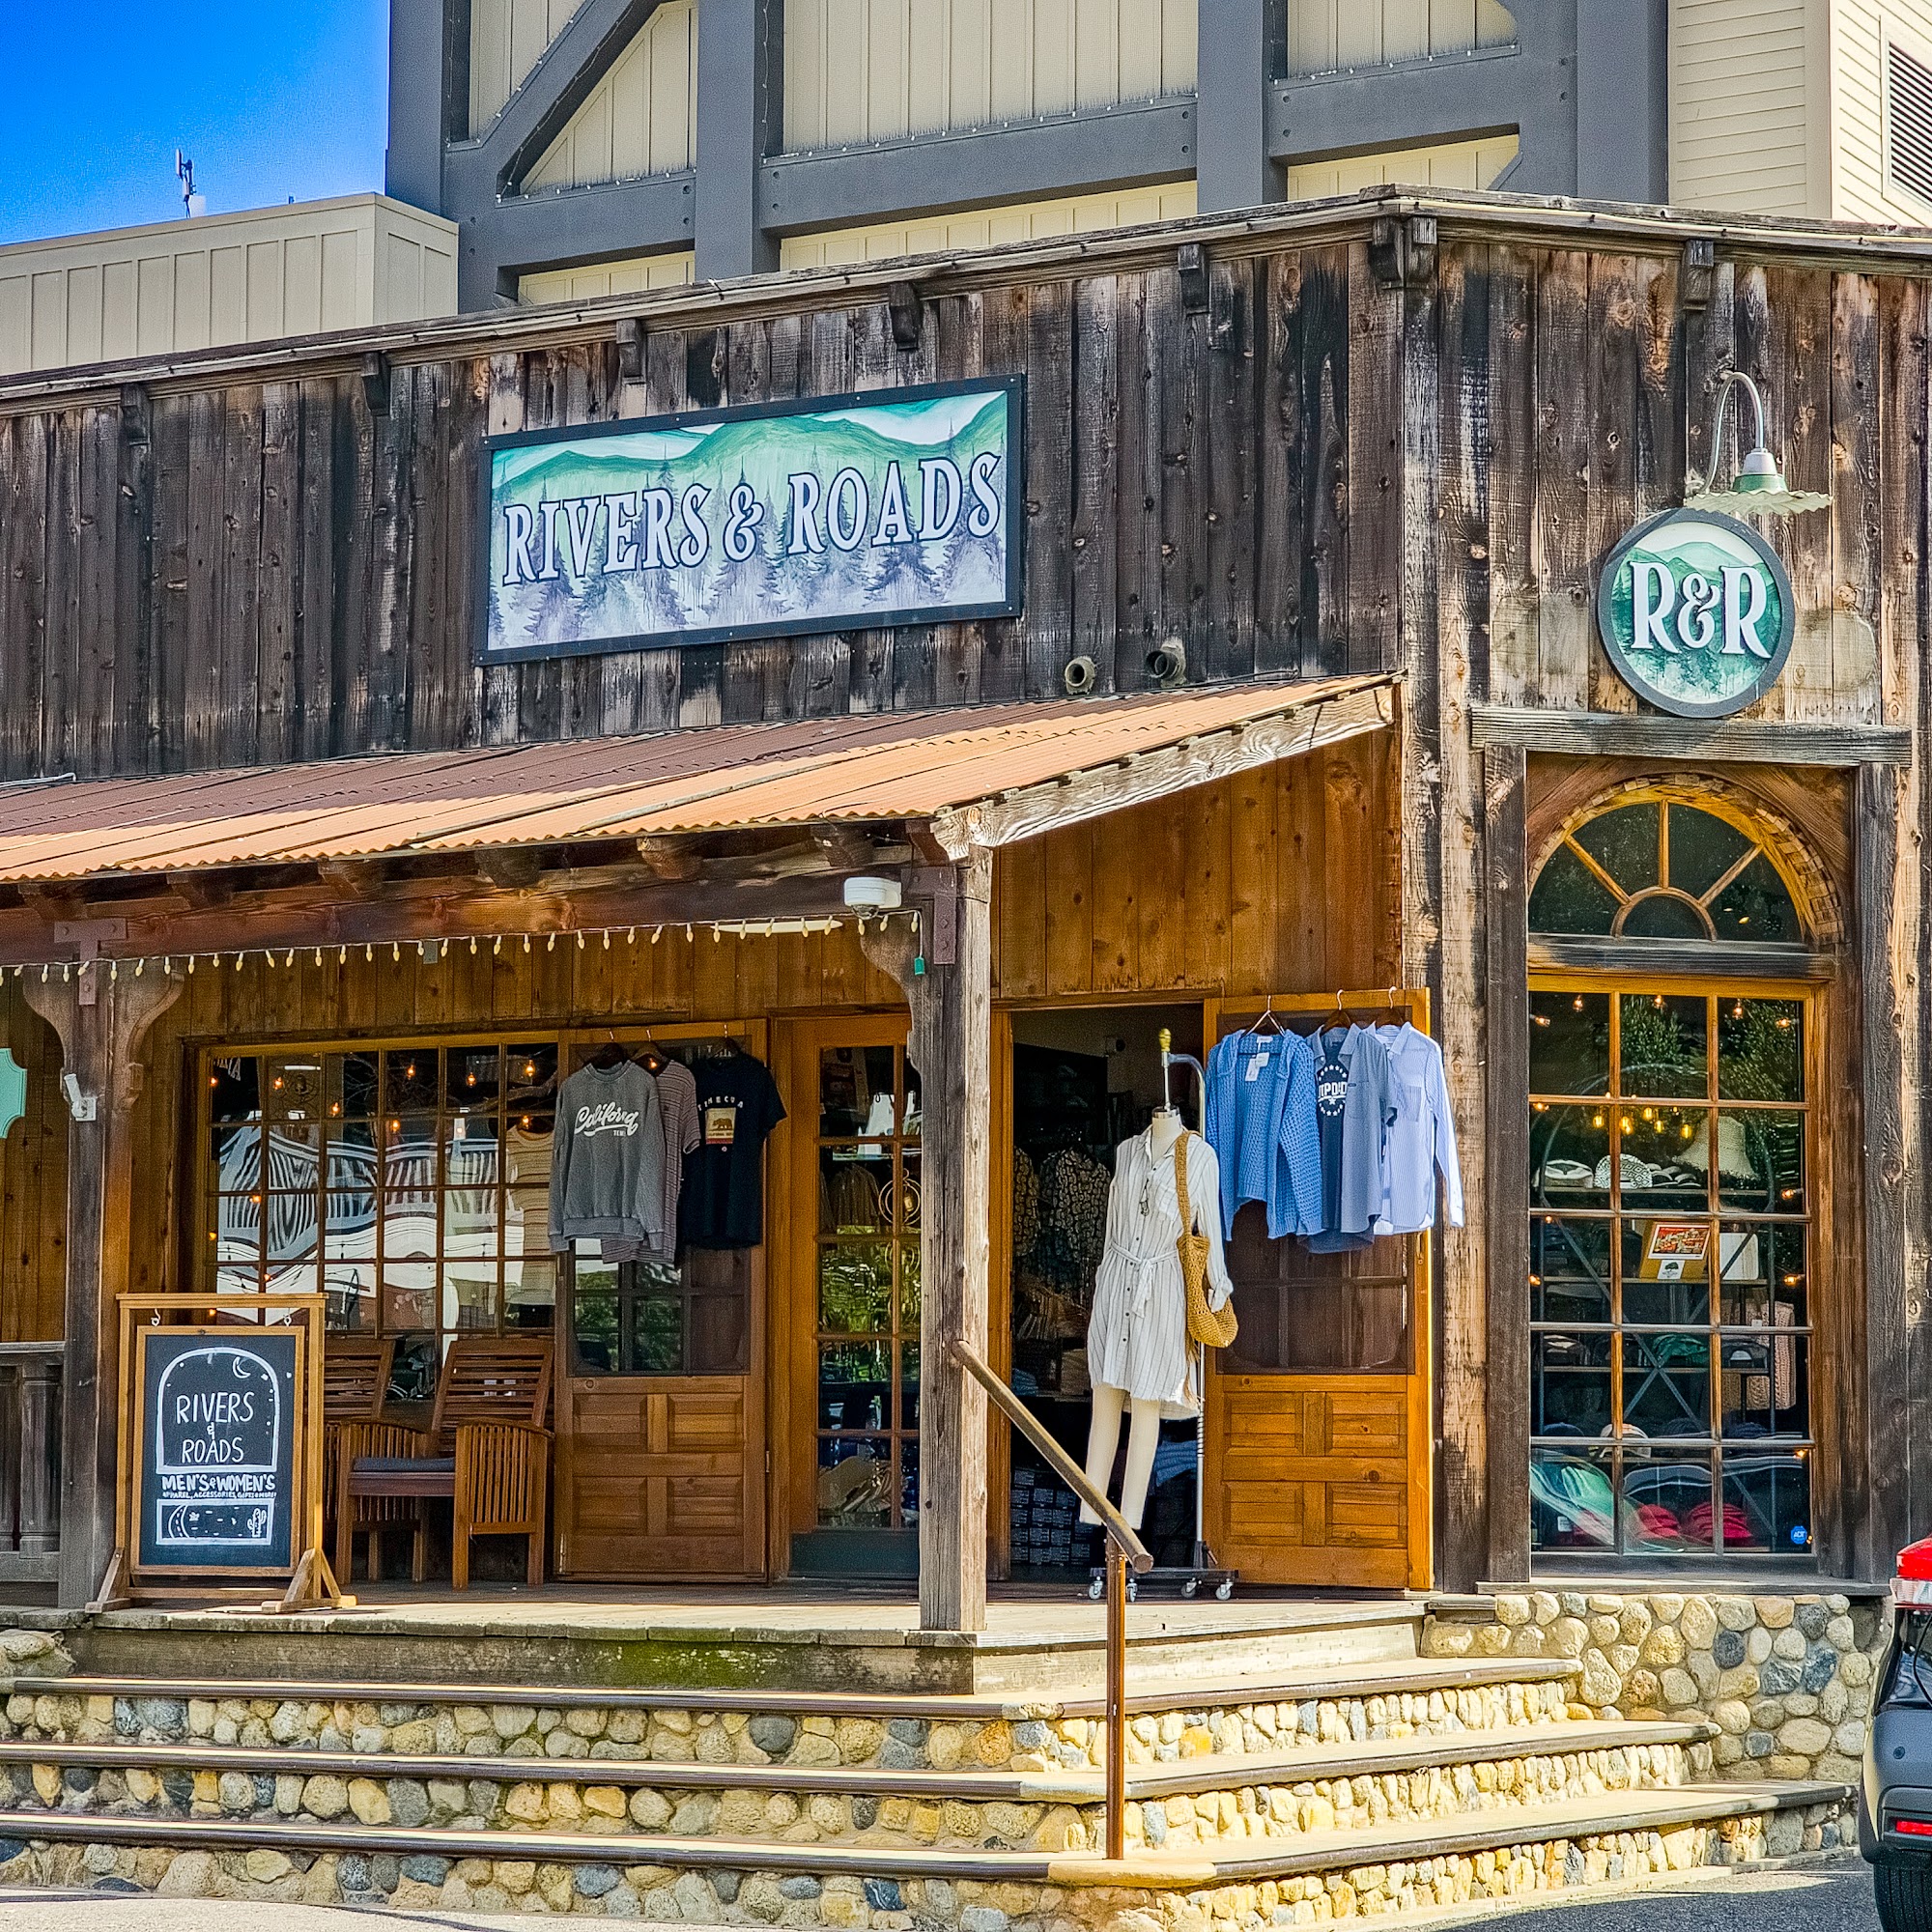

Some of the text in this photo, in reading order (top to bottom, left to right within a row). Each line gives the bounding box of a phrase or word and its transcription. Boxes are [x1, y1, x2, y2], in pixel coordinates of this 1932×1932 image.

[502, 452, 1003, 585] RIVERS & ROADS
[1628, 560, 1773, 659] R&R
[177, 1391, 255, 1424] RIVERS
[182, 1436, 244, 1463] ROADS
